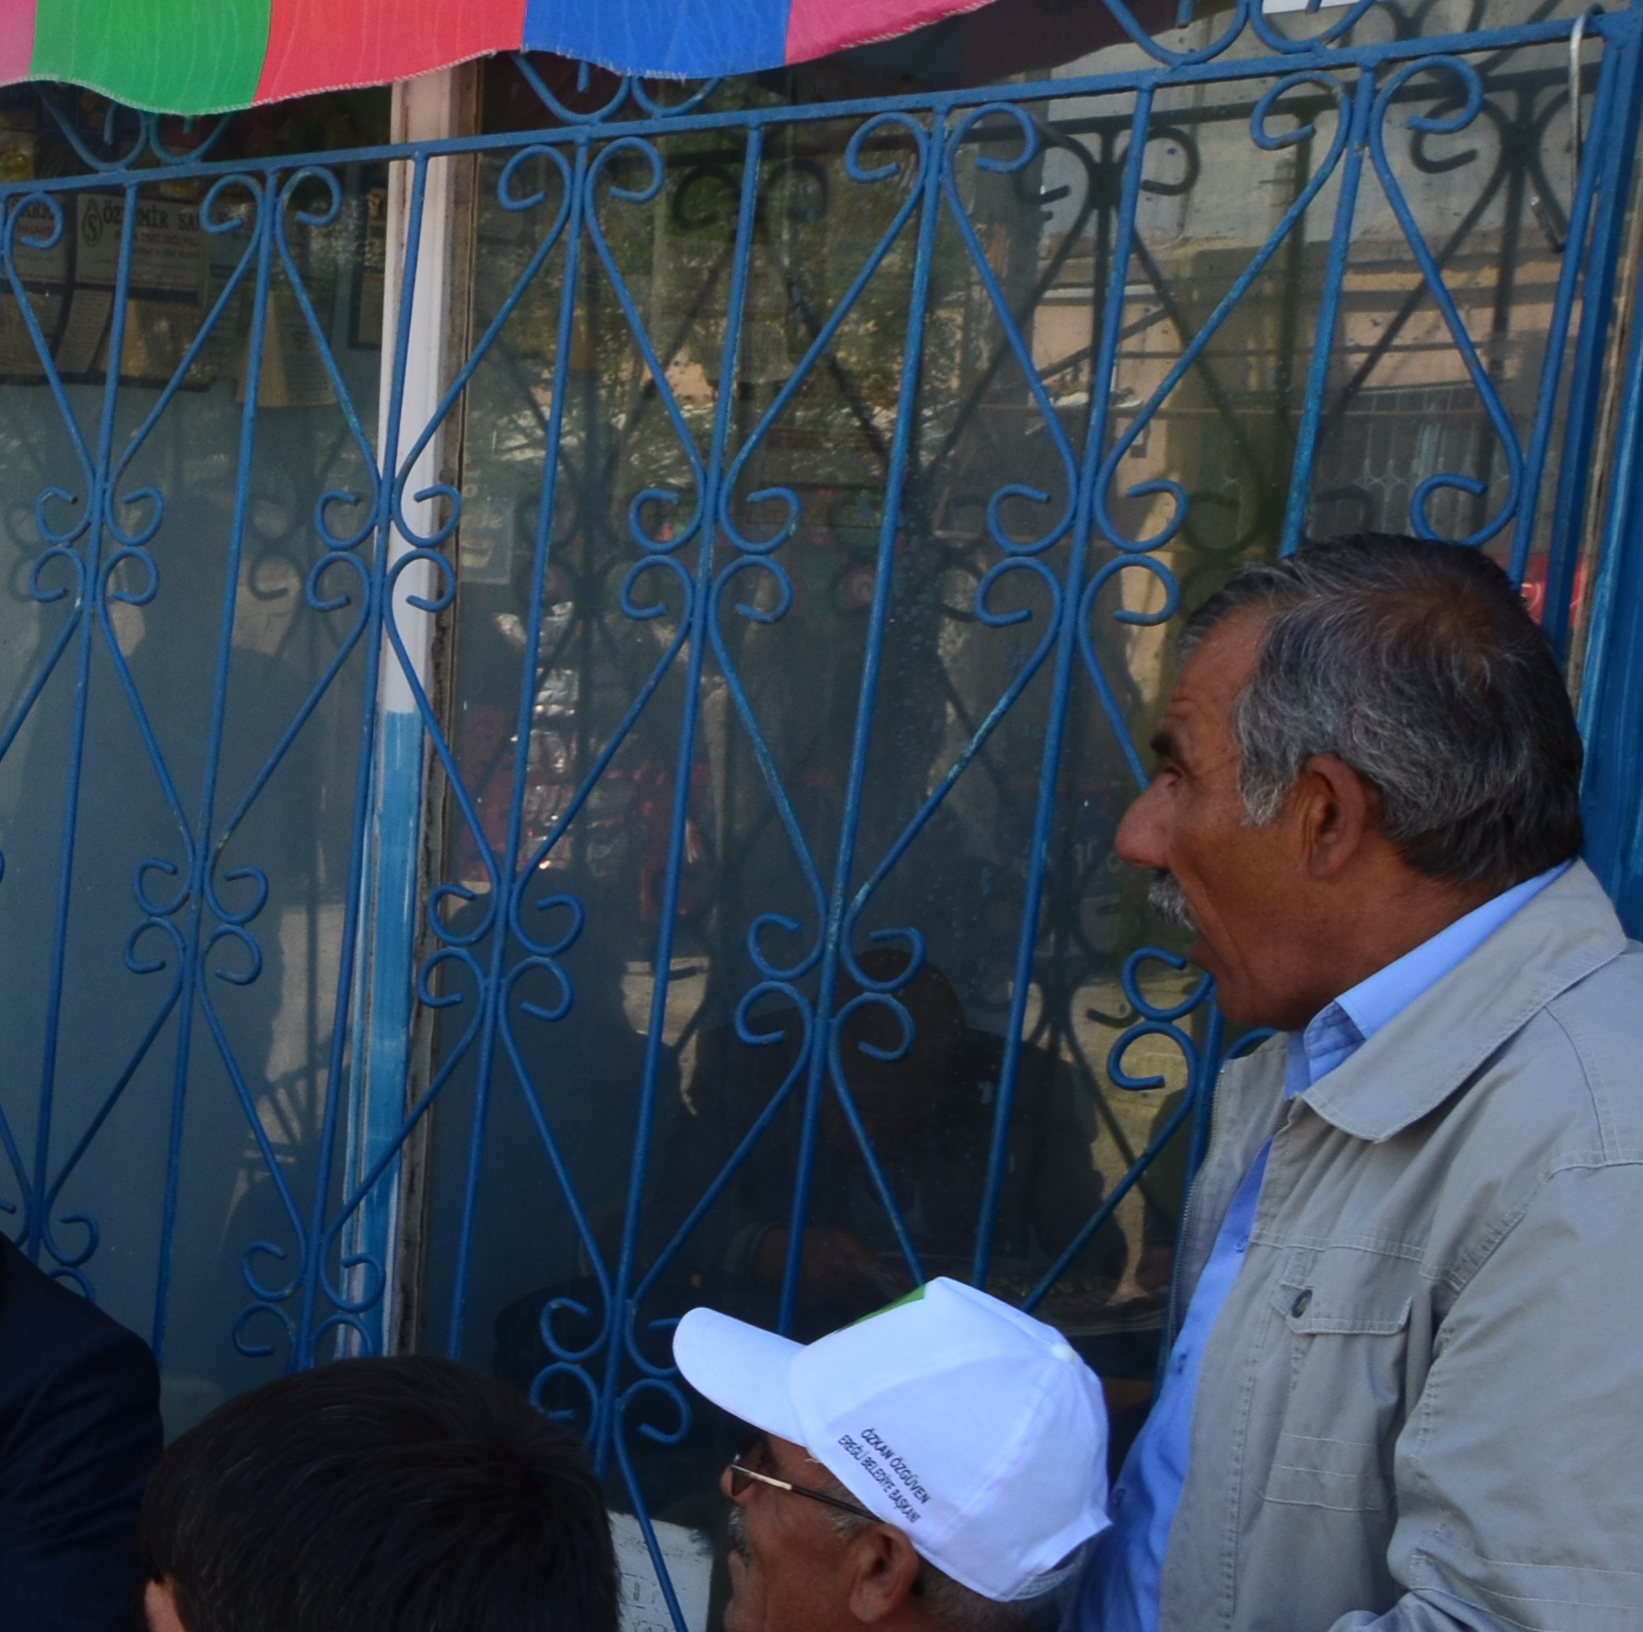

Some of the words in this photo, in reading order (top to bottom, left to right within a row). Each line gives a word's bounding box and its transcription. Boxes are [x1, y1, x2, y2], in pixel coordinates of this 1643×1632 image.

[103, 201, 168, 229] ÖZMİR
[838, 1434, 870, 1461] EREĞLİ
[861, 1455, 896, 1494] BELEDİYE
[861, 1427, 894, 1460] ÖZKAN
[889, 1456, 931, 1504] ÖZGÜVEN
